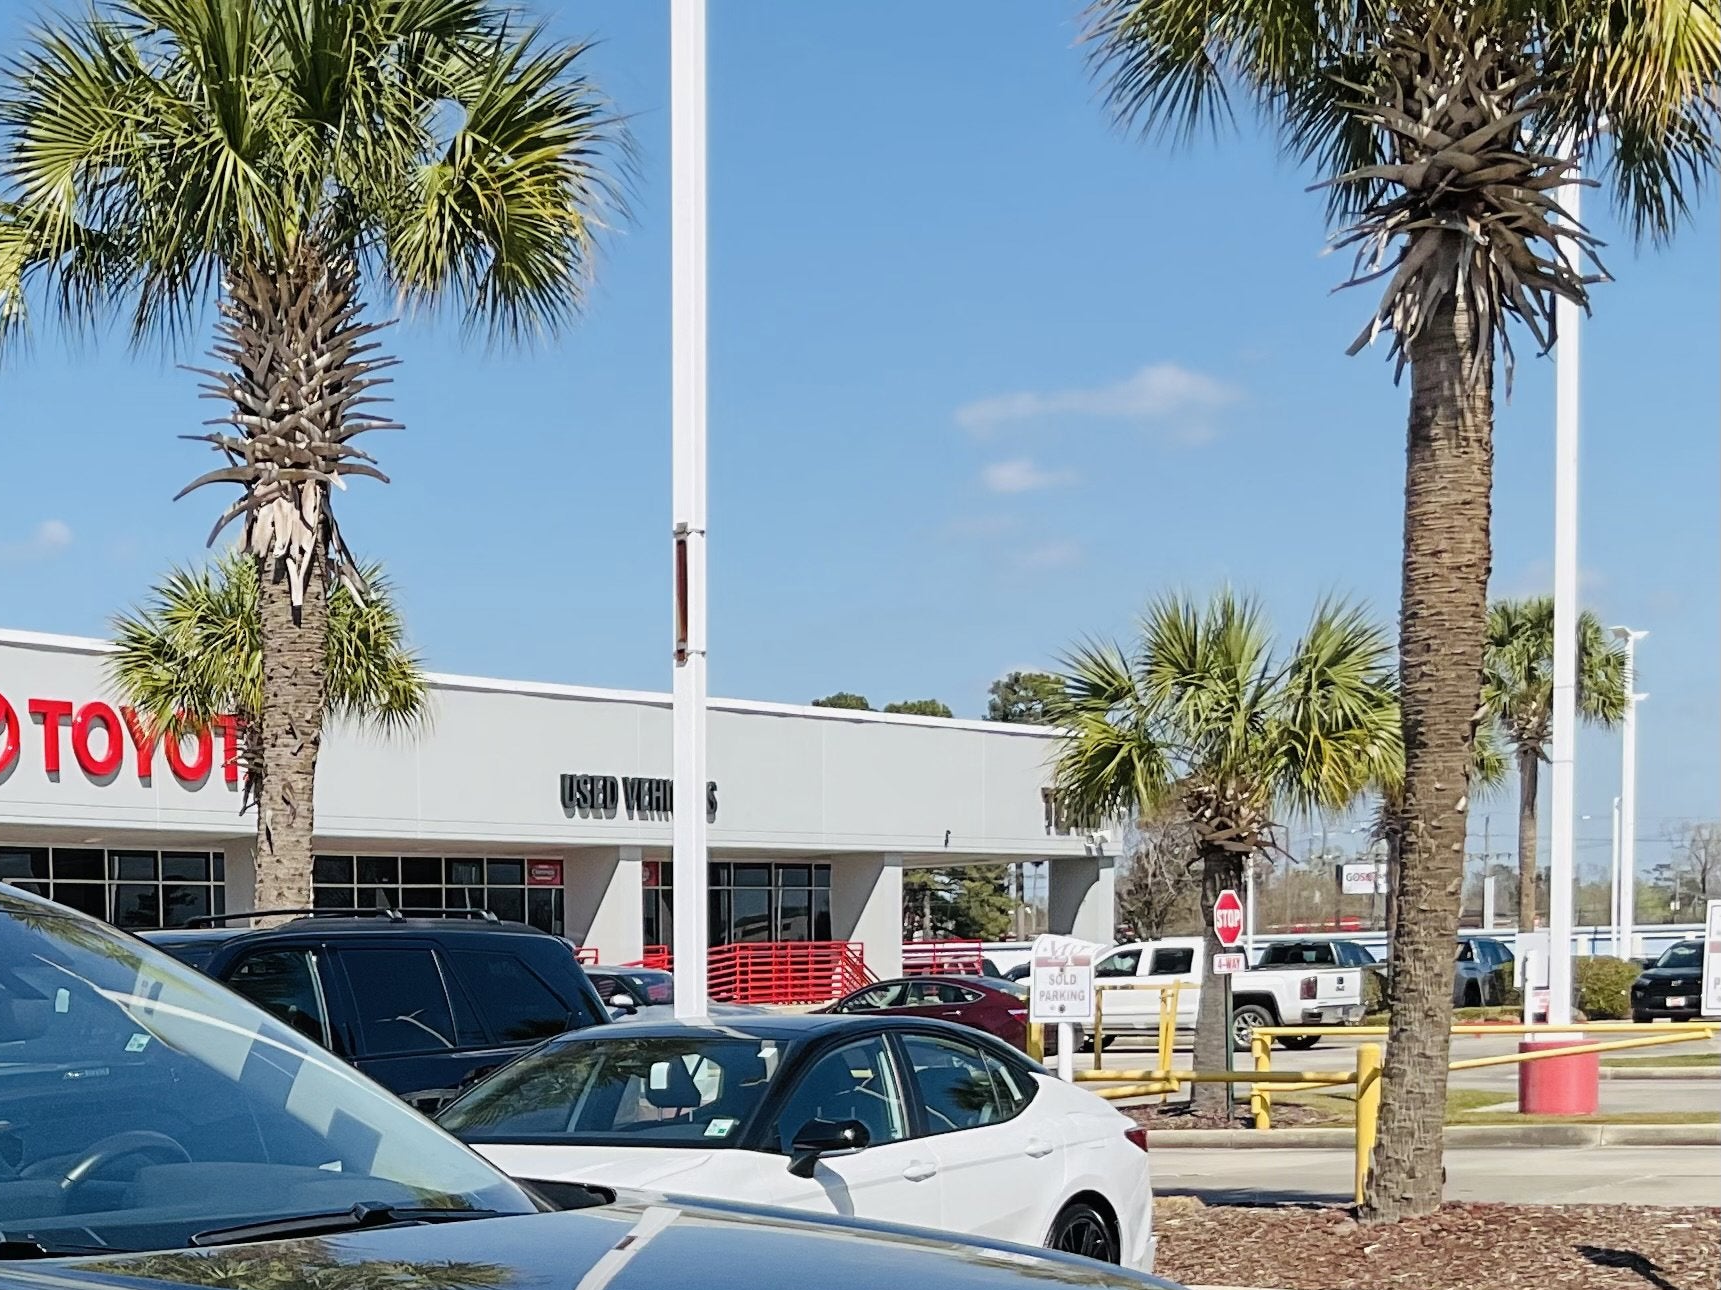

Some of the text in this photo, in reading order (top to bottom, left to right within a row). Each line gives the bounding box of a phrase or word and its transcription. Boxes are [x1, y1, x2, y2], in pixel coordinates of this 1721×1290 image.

[28, 698, 250, 783] TOYOT
[560, 773, 717, 817] USED VEHIS
[1216, 909, 1240, 928] STOP
[1217, 957, 1241, 969] 4-WAY
[1048, 973, 1077, 986] SOLD
[1039, 989, 1086, 1002] PARKING
